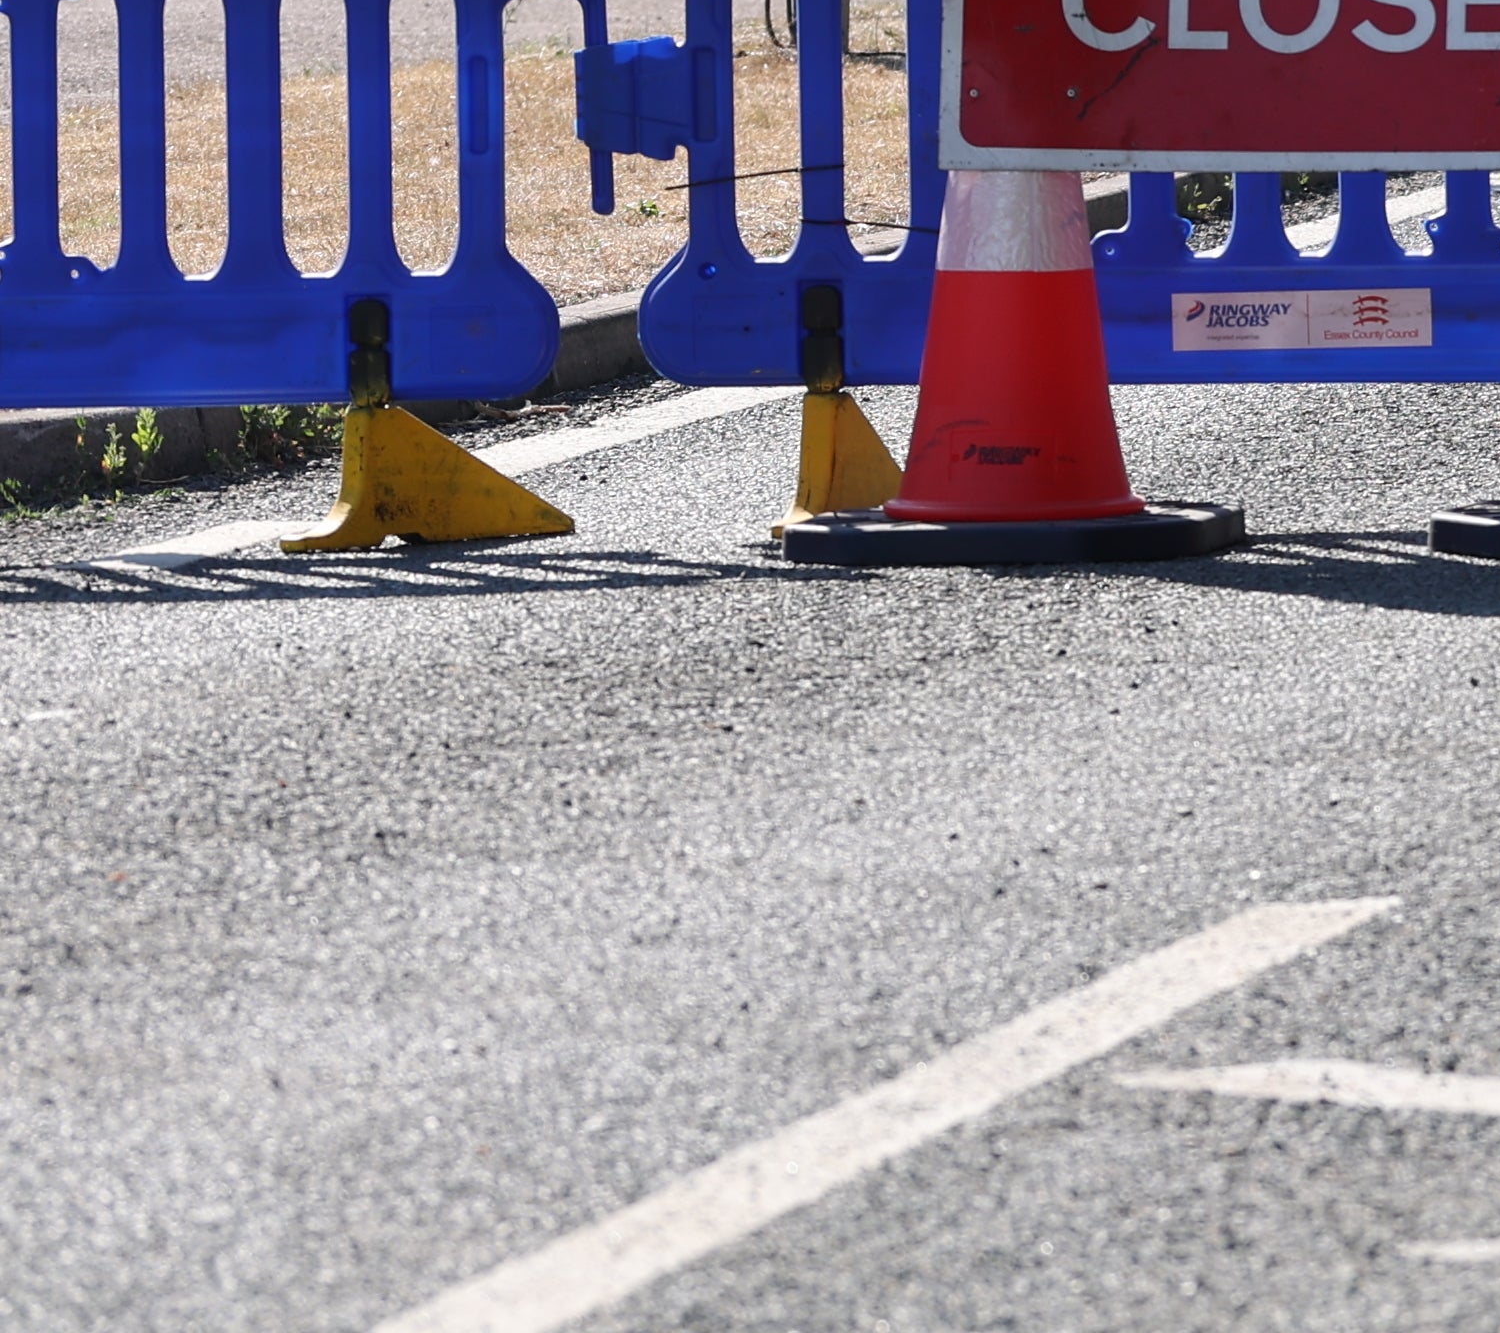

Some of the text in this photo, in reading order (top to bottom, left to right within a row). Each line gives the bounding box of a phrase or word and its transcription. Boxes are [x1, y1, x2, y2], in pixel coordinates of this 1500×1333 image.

[1209, 303, 1292, 316] RINGWAY
[1205, 315, 1270, 328] JACOBS
[1324, 329, 1419, 341] Essex County Council
